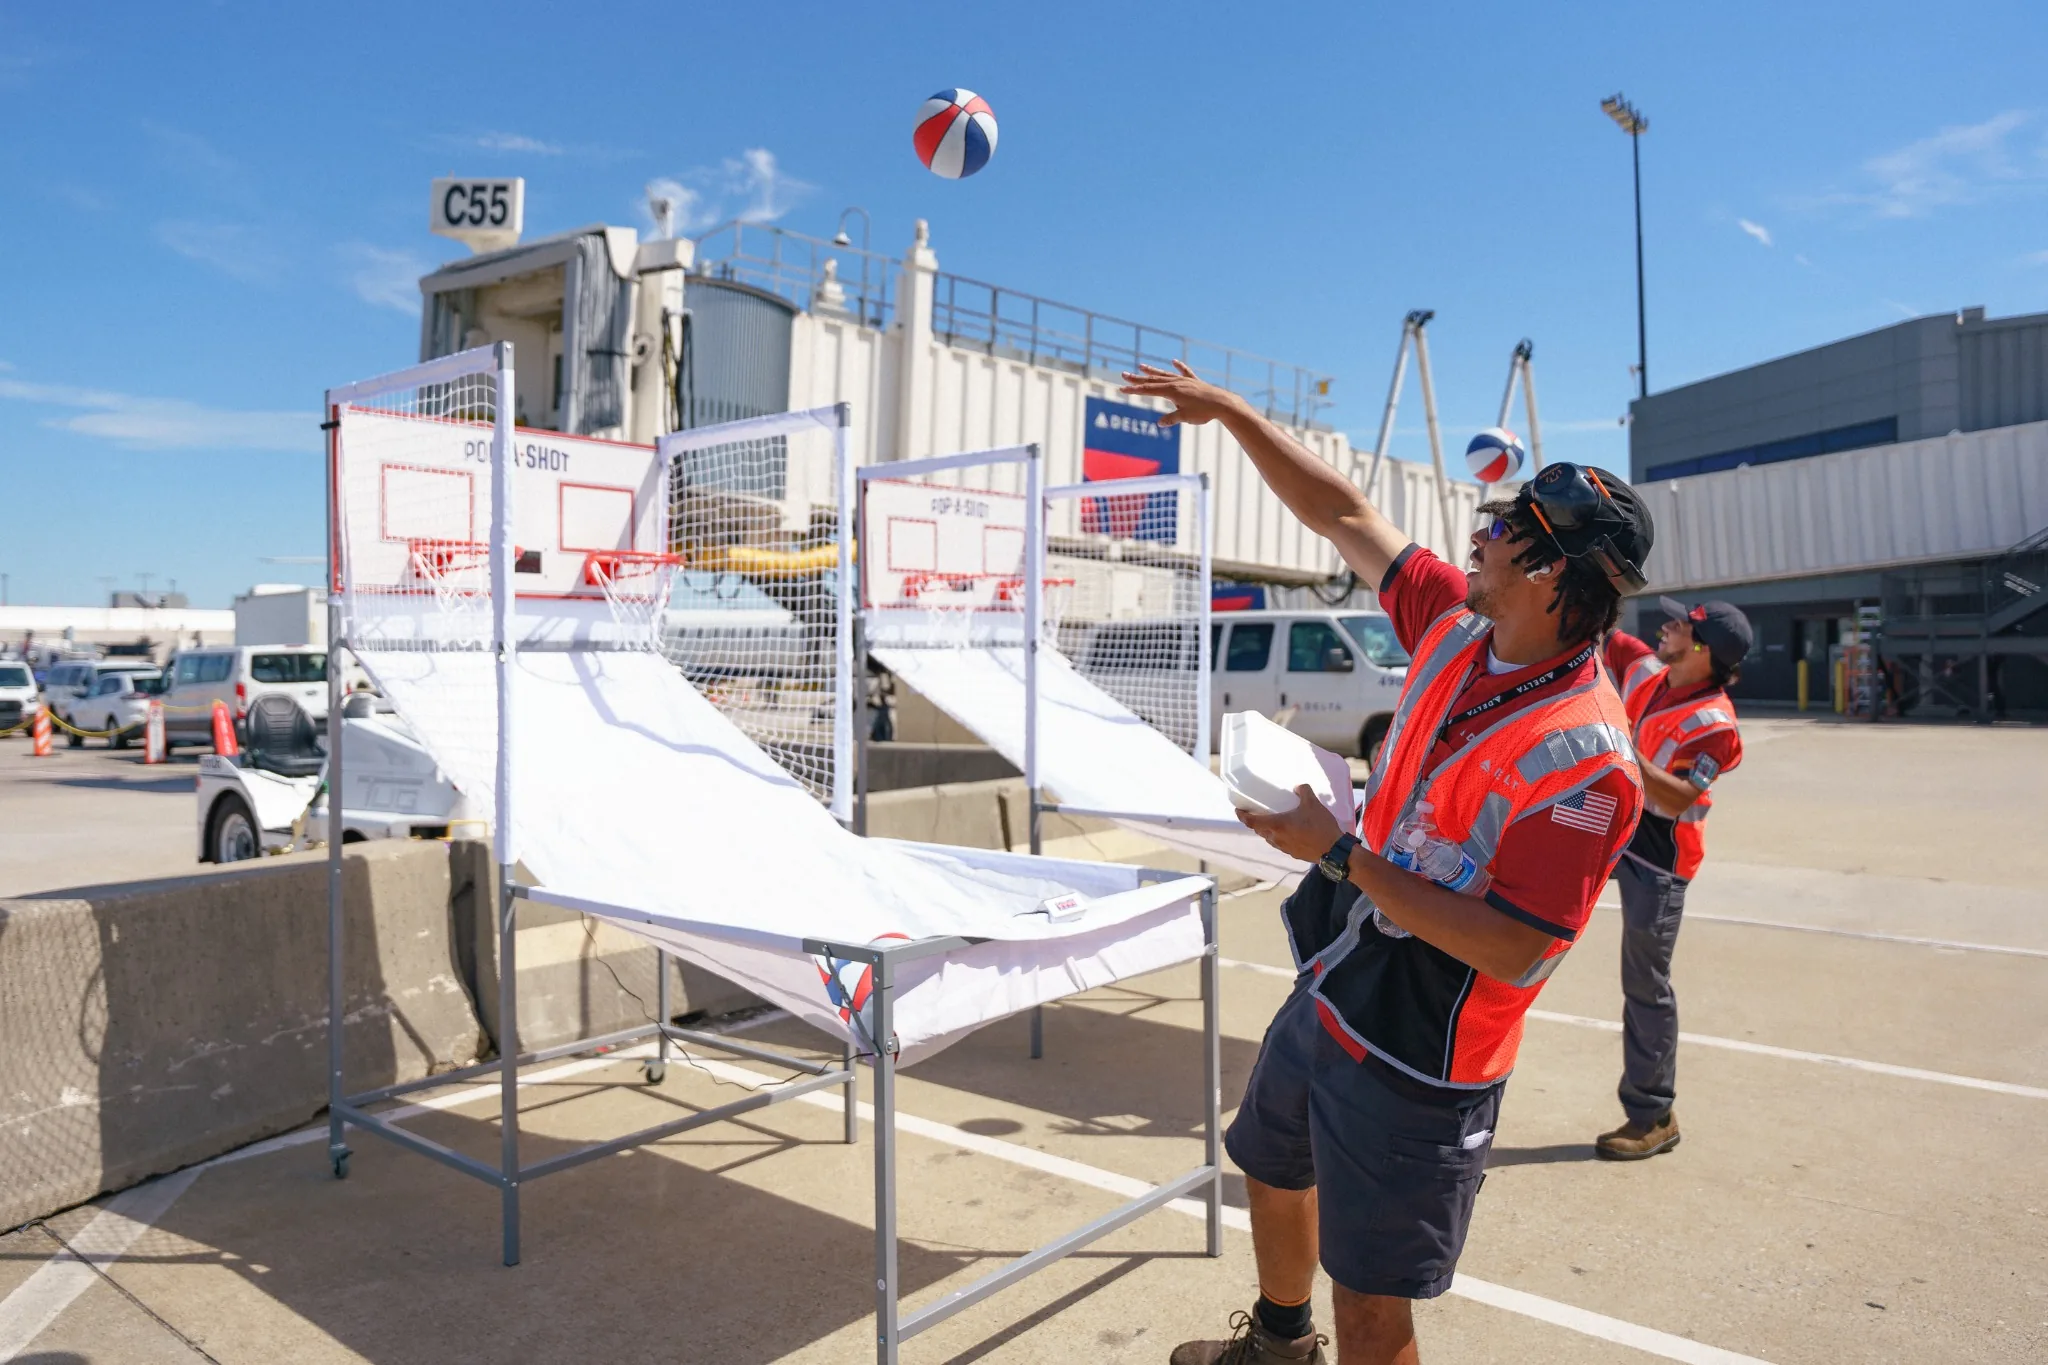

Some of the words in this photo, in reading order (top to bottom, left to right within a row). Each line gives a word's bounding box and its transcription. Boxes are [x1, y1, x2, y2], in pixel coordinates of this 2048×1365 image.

[445, 183, 509, 226] C55
[1110, 414, 1159, 438] DELTA
[1516, 675, 1546, 693] DELTA
[1304, 702, 1342, 711] DELTA
[1467, 700, 1494, 716] DELTA
[357, 775, 424, 810] TUG
